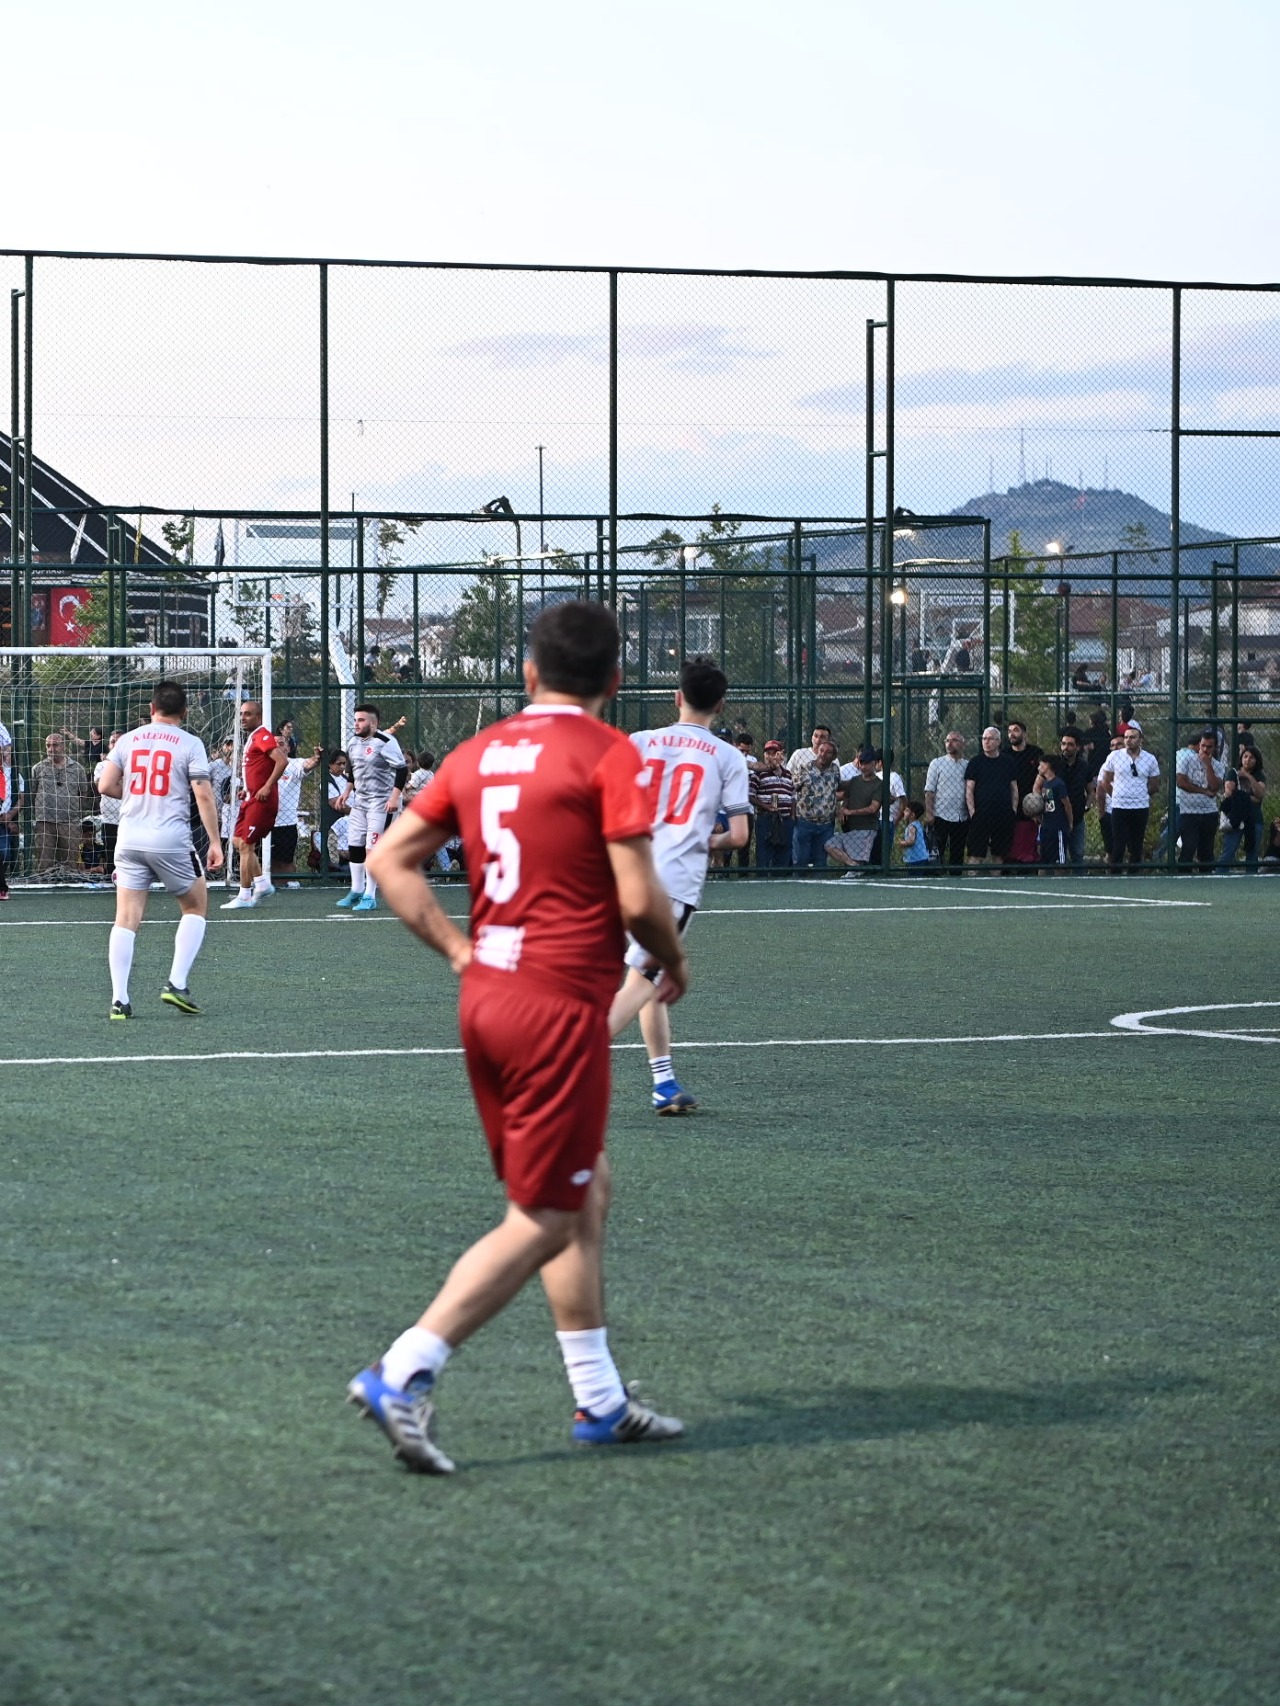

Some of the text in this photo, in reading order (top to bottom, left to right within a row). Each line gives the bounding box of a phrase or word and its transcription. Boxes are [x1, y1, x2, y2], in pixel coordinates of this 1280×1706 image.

[648, 735, 717, 756] KALEDİBİ
[129, 748, 173, 797] 58
[644, 758, 705, 826] 10
[248, 825, 257, 838] 7
[480, 784, 521, 905] 5
